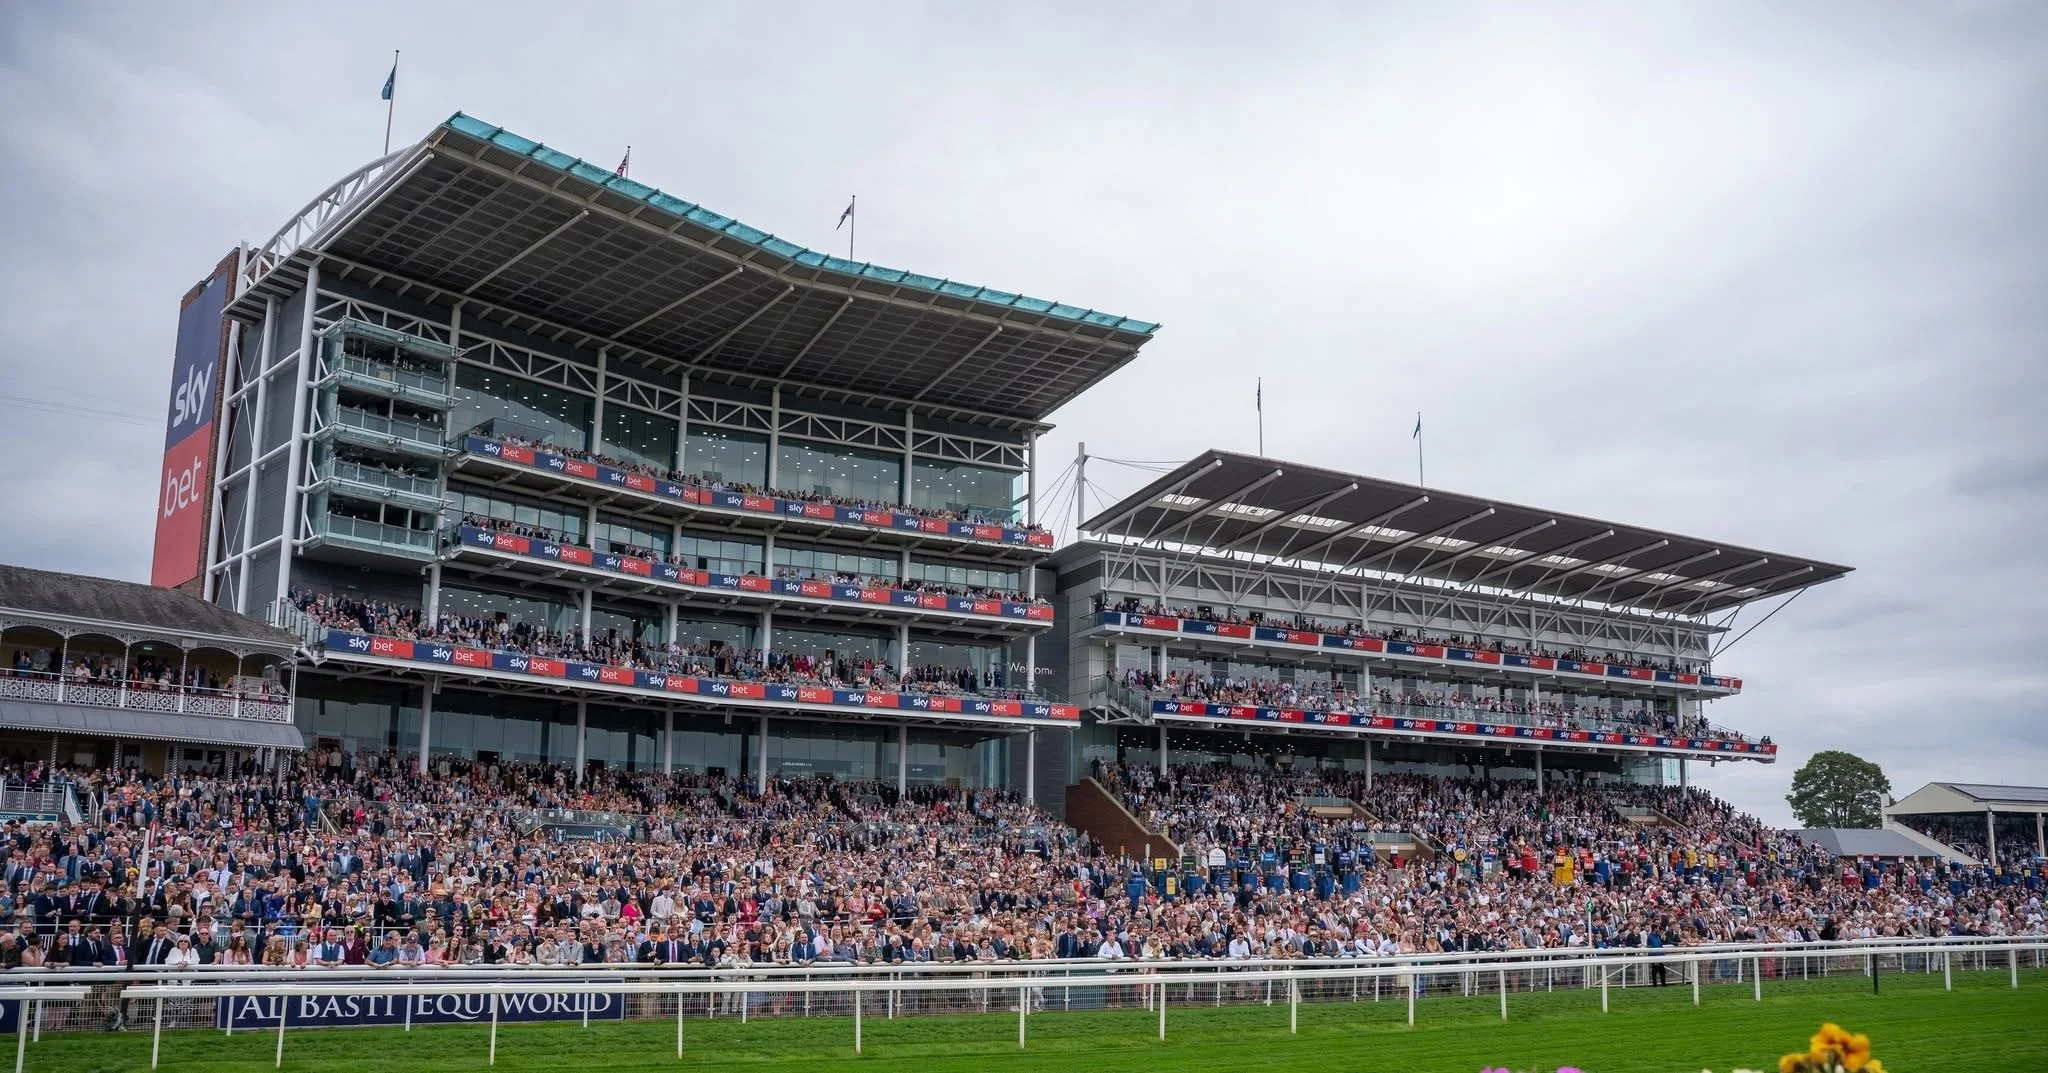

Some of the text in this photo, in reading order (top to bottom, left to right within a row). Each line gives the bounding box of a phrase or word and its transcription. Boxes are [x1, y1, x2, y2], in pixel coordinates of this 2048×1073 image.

[173, 361, 213, 428] sky
[484, 442, 519, 458] sky bet
[550, 457, 582, 473] sky bet
[628, 475, 642, 486] bet
[164, 456, 202, 518] bet
[669, 485, 697, 499] sky bet
[728, 496, 760, 508] sky bet
[789, 504, 820, 514] sky bet
[848, 511, 878, 522] sky bet
[905, 518, 918, 528] sky
[961, 525, 988, 536] sky bet
[478, 532, 512, 546] sky bet
[1014, 532, 1041, 542] sky bet
[544, 545, 577, 558] sky bet
[624, 559, 638, 569] bet
[664, 568, 693, 580] sky bet
[724, 576, 756, 587] sky bet
[786, 582, 817, 593] sky bet
[846, 588, 876, 598] sky bet
[904, 594, 917, 604] sky
[960, 601, 988, 610] sky bet
[1014, 606, 1040, 616] sky bet
[1130, 616, 1154, 625] sky bet
[1206, 623, 1228, 633] sky bet
[1277, 631, 1298, 640] sky bet
[349, 637, 393, 651] sky bet
[1344, 638, 1364, 648] sky bet
[432, 648, 474, 662] sky bet
[1416, 646, 1425, 654] bet
[1464, 652, 1484, 660] sky bet
[1520, 657, 1529, 665] sky
[510, 658, 549, 671] sky bet
[1008, 661, 1055, 676] Weome
[582, 666, 618, 680] sky bet
[650, 675, 683, 688] sky bet
[712, 684, 748, 696] sky bet
[781, 688, 816, 700] sky bet
[848, 693, 883, 704] sky bet
[913, 698, 928, 709] sky
[975, 702, 1006, 712] sky bet
[1034, 706, 1065, 716] sky bet
[1166, 702, 1192, 712] sky bet
[1217, 706, 1243, 716] sky bet
[1267, 710, 1292, 719] sky bet
[1314, 714, 1338, 722] sky bet
[1360, 716, 1382, 725] sky bet
[1403, 720, 1426, 728] sky bet
[1444, 722, 1466, 731] sky bet
[1486, 725, 1496, 733] sky
[1523, 728, 1543, 736] sky bet
[1560, 730, 1580, 739] sky bet
[235, 996, 282, 1020] AL
[297, 995, 395, 1018] BASTI
